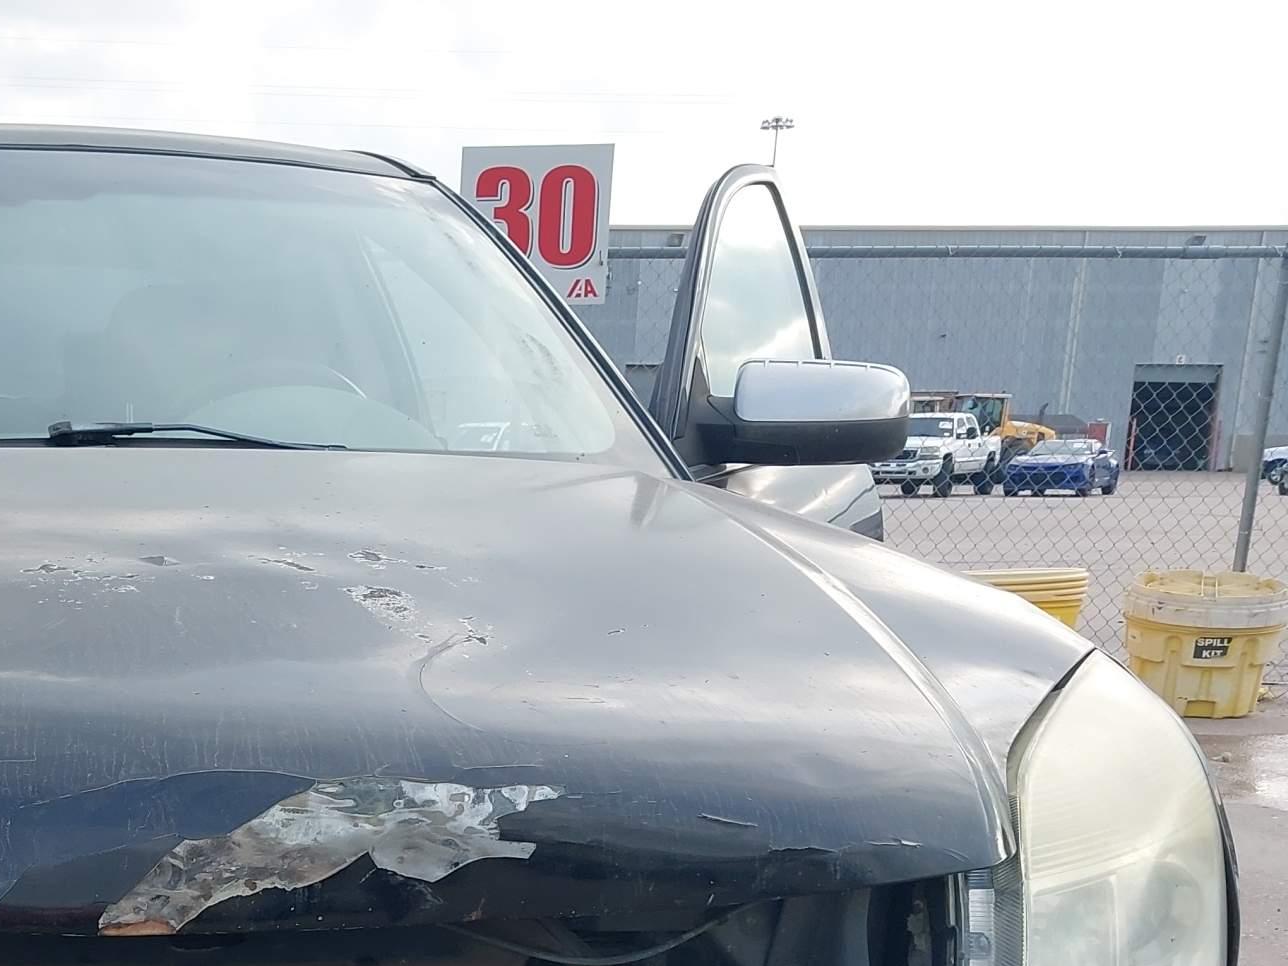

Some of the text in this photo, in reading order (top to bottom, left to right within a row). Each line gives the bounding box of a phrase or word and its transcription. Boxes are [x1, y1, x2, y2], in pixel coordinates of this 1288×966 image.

[475, 164, 599, 269] 30
[1196, 637, 1231, 647] SPILL
[1201, 649, 1224, 659] KIT
